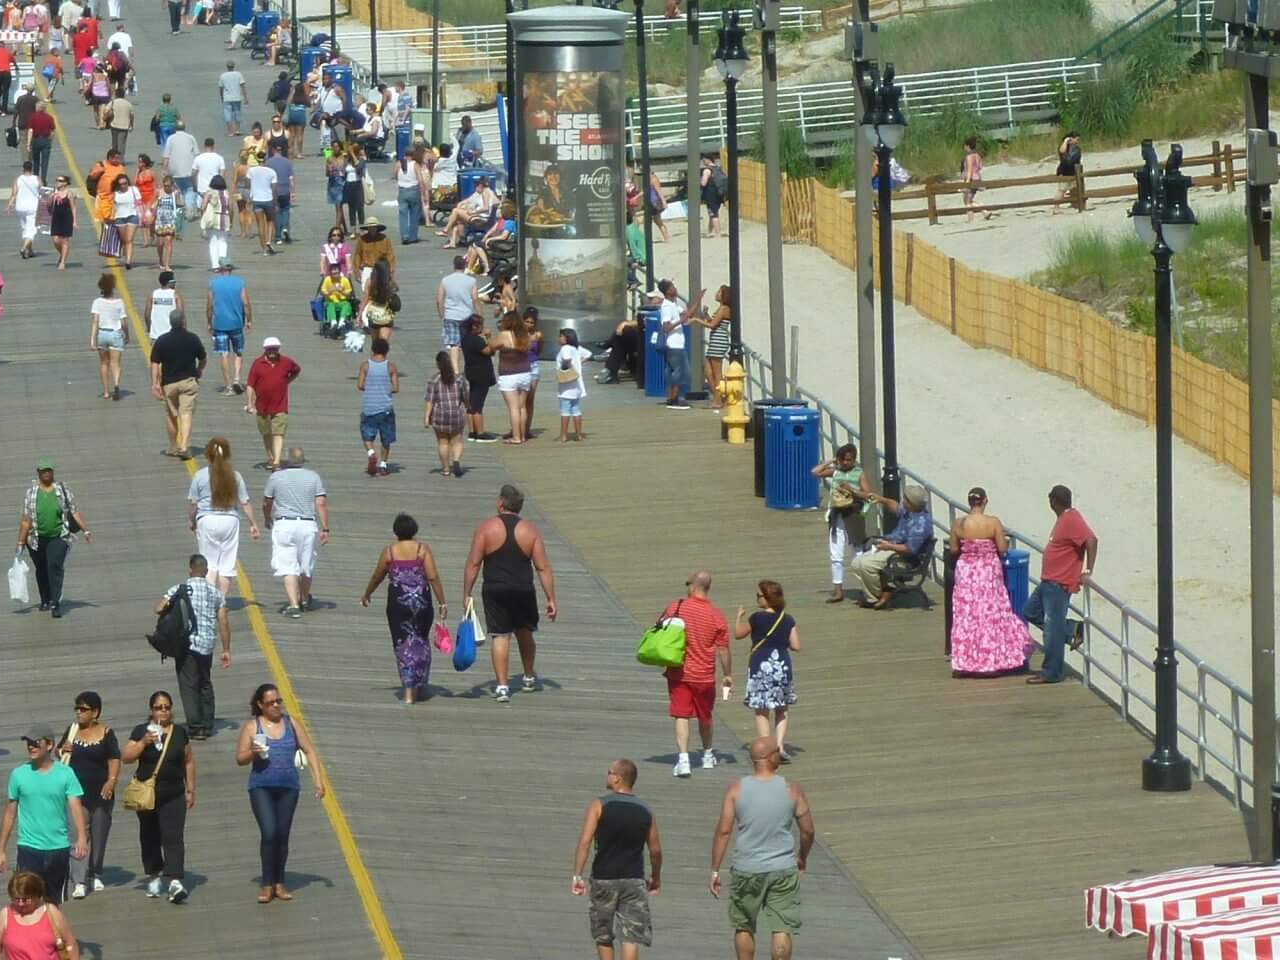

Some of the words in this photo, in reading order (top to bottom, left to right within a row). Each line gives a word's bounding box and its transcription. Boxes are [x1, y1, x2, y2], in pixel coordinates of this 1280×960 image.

[556, 113, 601, 129] SEE
[536, 129, 580, 145] THE
[579, 173, 603, 185] Hard
